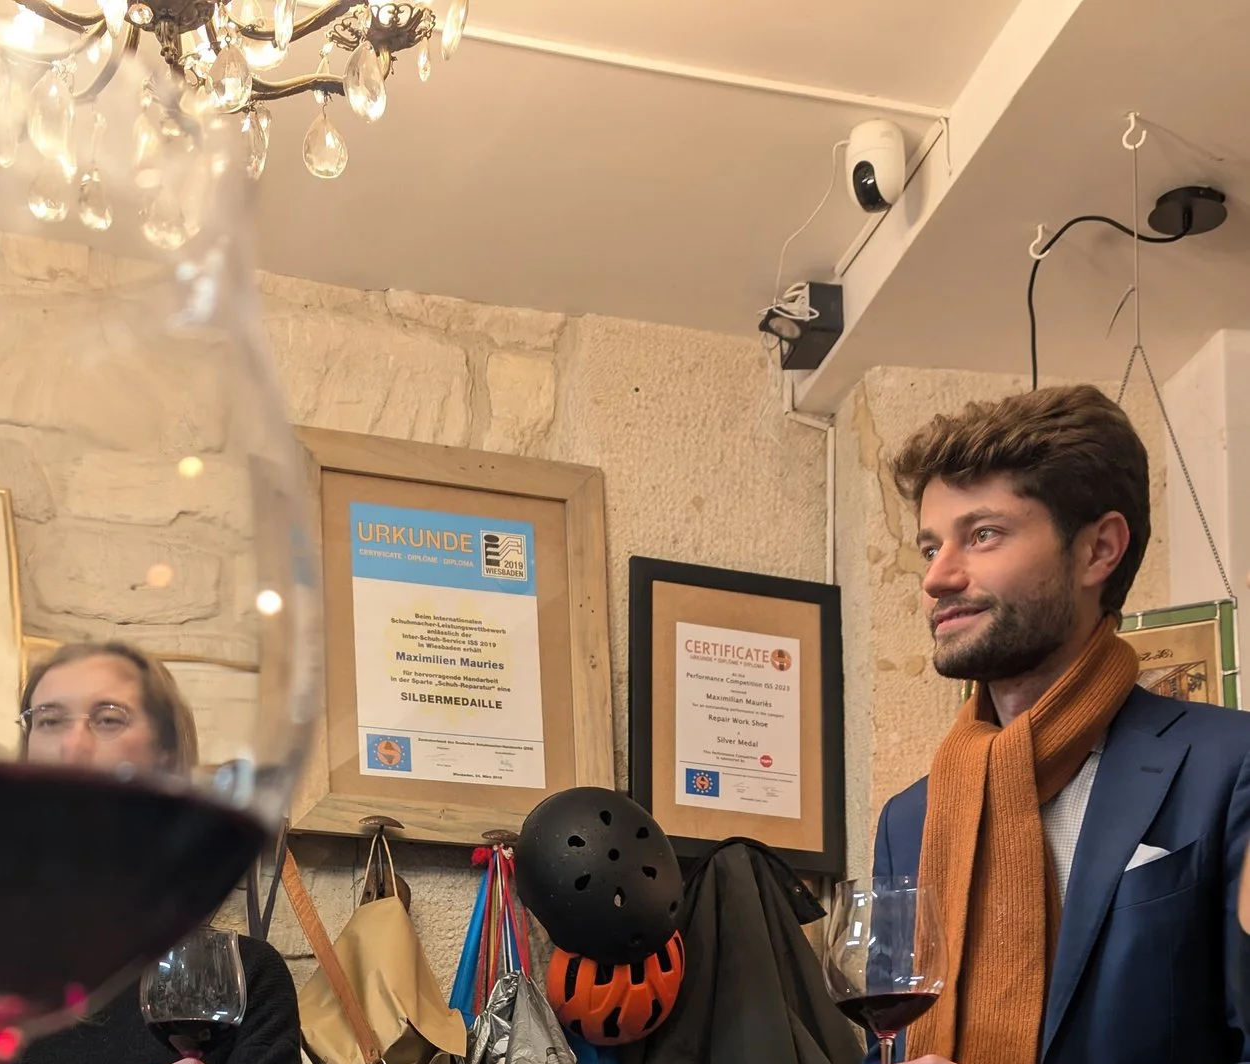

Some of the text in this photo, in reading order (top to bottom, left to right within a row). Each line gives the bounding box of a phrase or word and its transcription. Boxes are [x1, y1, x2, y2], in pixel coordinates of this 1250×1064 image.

[357, 521, 474, 553] URKUNDE
[359, 548, 403, 560] CERTIFICATE
[443, 558, 474, 568] DIPLOMA
[504, 560, 524, 570] 2019
[485, 567, 524, 578] WIESBADEN
[433, 615, 482, 625] Internationalen
[427, 628, 459, 637] anlässlich
[426, 642, 461, 652] Wiesbaden
[685, 639, 770, 663] CERTIFICATE
[395, 651, 505, 670] Maximilien Mauries
[411, 678, 433, 686] Sparte
[414, 671, 461, 681] hervorragende
[463, 675, 499, 684] Handarbeit
[686, 672, 724, 683] Performance
[726, 677, 763, 688] Competition
[400, 691, 503, 710] SILBERMEDAILLE
[706, 693, 743, 704] Maximilian
[708, 714, 768, 728] Repair Work Shoe
[717, 736, 759, 748] Silver Medal
